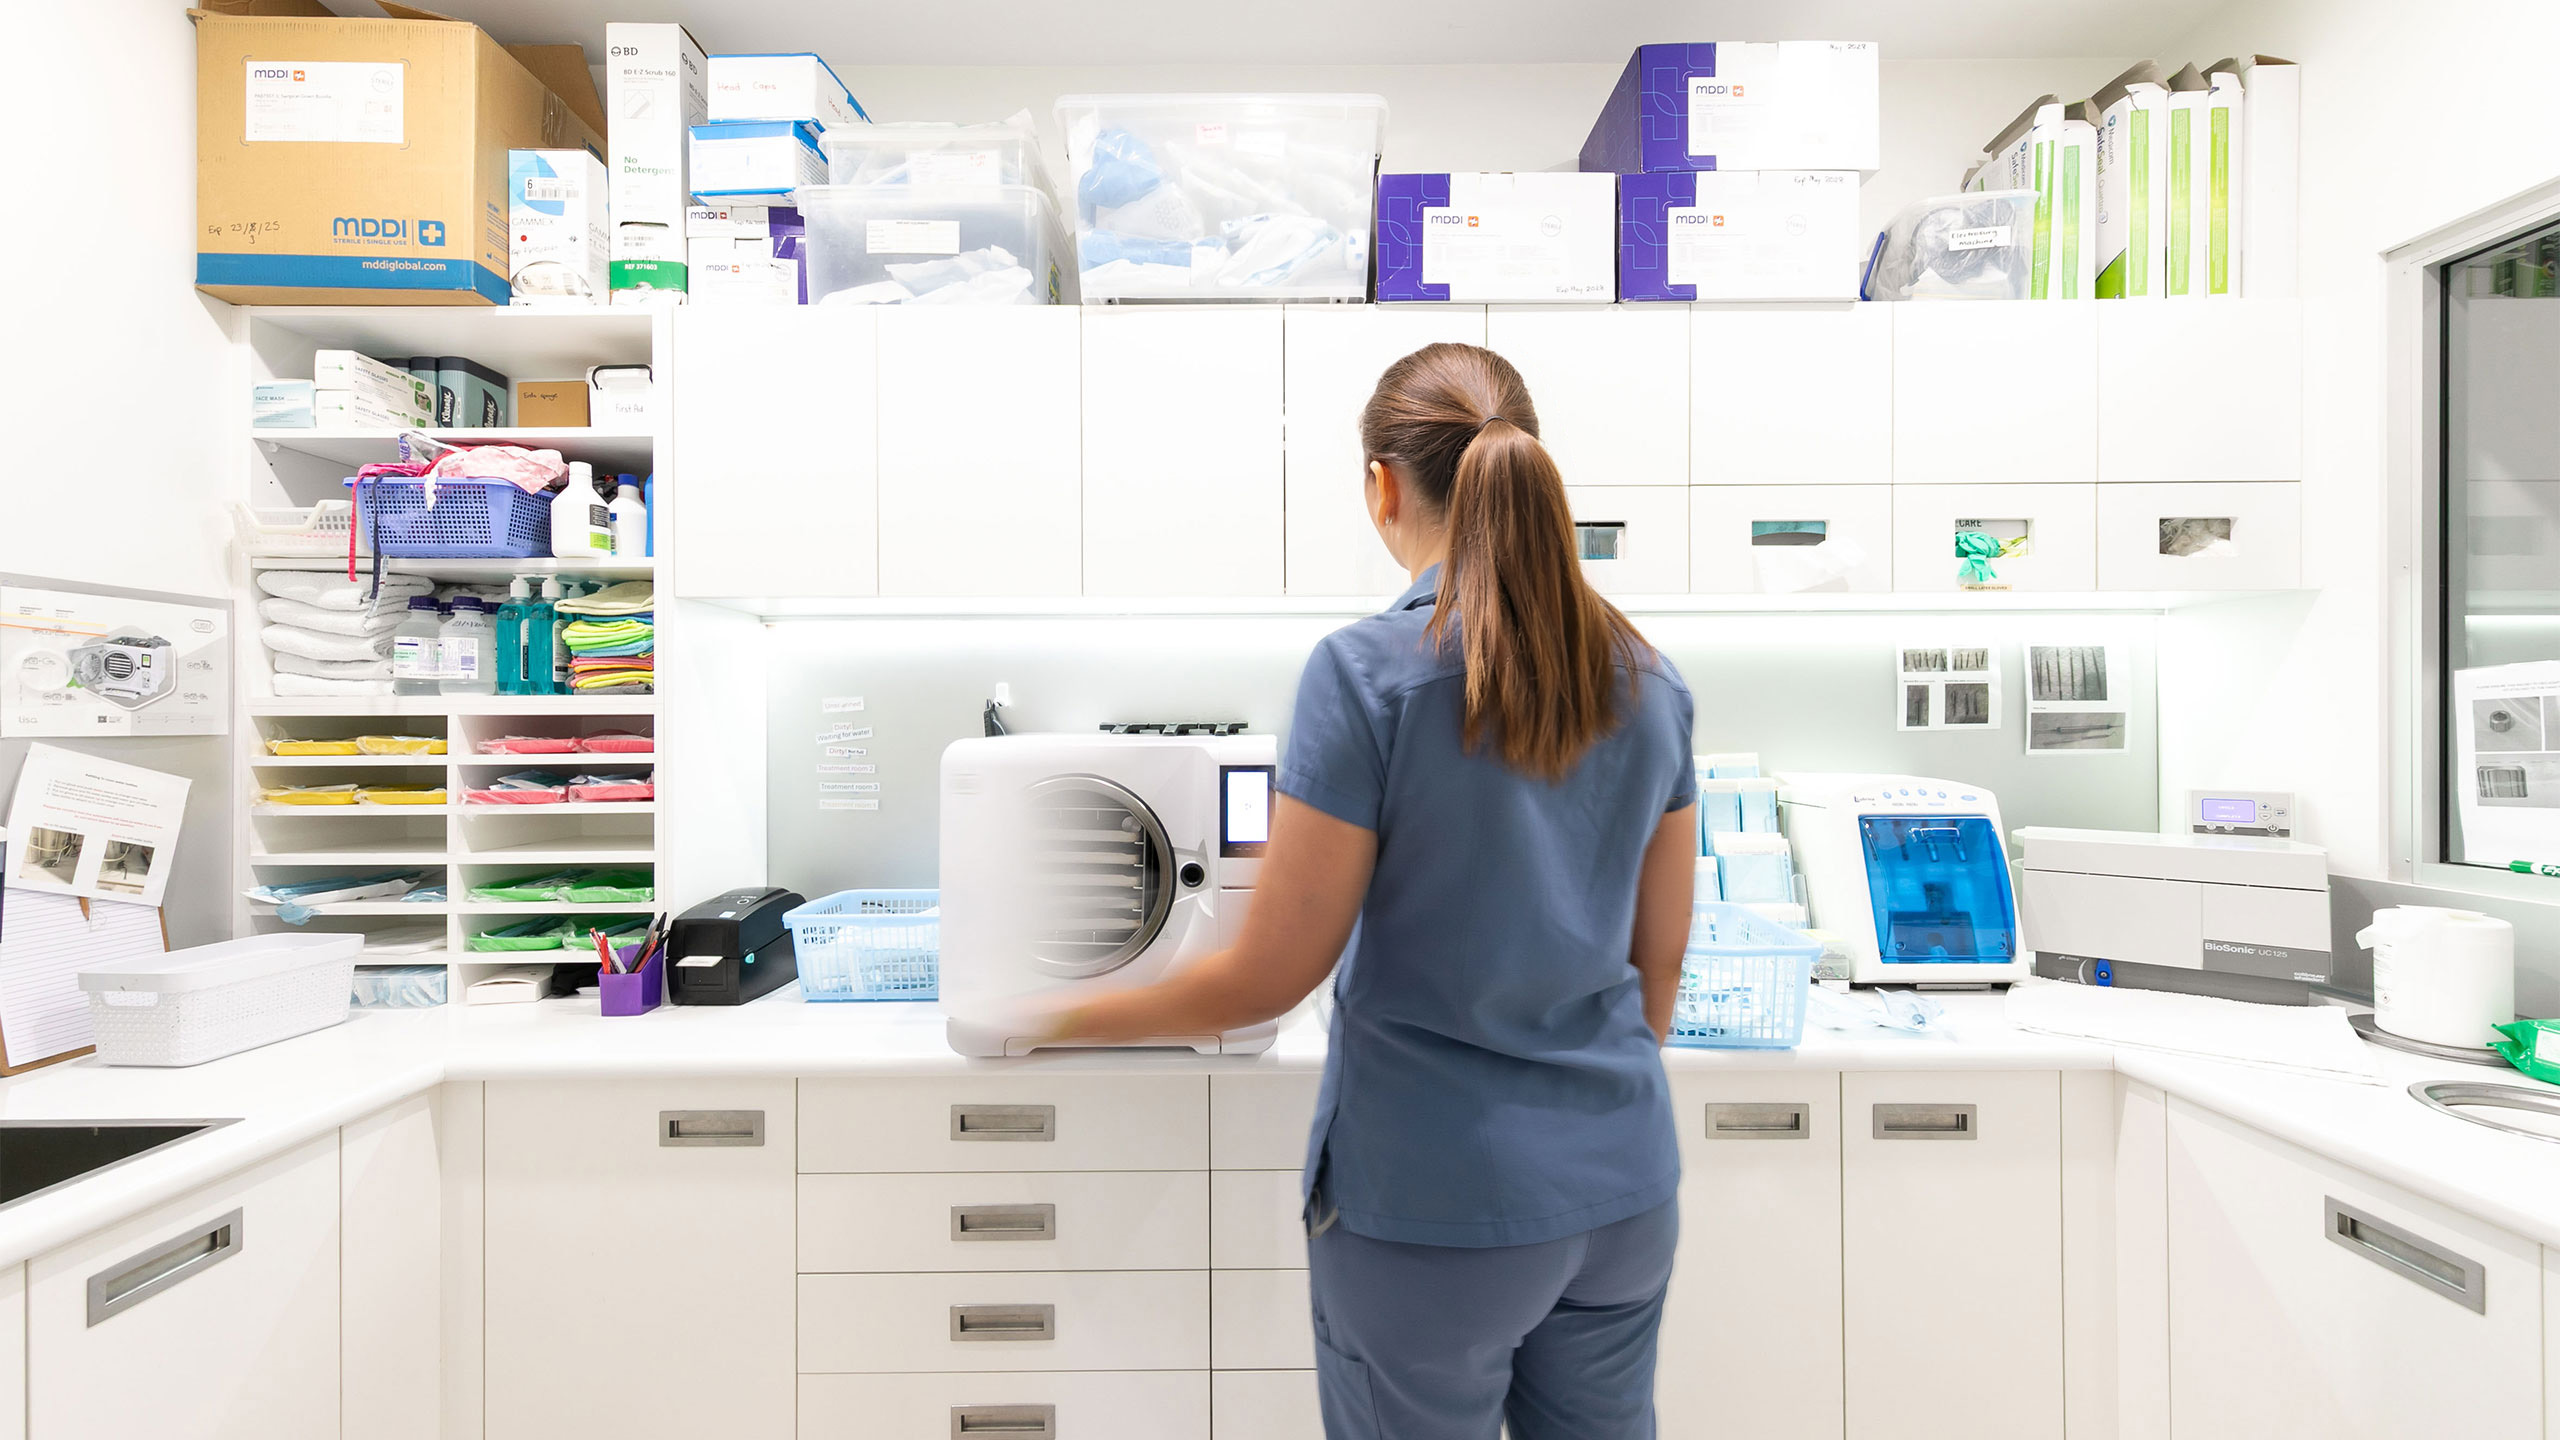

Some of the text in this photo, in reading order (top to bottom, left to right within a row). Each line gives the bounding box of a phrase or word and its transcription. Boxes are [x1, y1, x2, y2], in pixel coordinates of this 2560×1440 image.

[623, 47, 638, 56] BD
[254, 69, 288, 79] MDDI
[645, 68, 663, 76] Scrub
[717, 81, 776, 92] Head Caps
[1695, 85, 1728, 95] MDDI
[828, 95, 841, 117] Head
[2096, 126, 2105, 175] SafeSeal
[624, 156, 638, 164] No
[624, 165, 676, 177] Detergent
[527, 179, 533, 189] 6
[690, 211, 718, 220] MDDI
[1431, 215, 1463, 225] MDDI
[1675, 215, 1708, 225] MDDI
[511, 217, 554, 226] GAMMEX
[208, 224, 223, 235] Exp
[333, 217, 407, 238] MDDI
[362, 260, 447, 272] mddiglobal.com
[705, 264, 729, 272] MDDI
[354, 365, 389, 383] SAFETY GLASSES
[442, 391, 453, 422] Kleenex
[615, 403, 644, 413] First Aid
[354, 405, 390, 421] SAFETY GLASSES
[484, 399, 497, 427] leenex
[817, 732, 842, 742] Waiting
[852, 729, 870, 737] water
[818, 764, 850, 772] Treatment
[821, 783, 854, 791] Treatment
[873, 783, 879, 791] 3
[2204, 942, 2255, 955] BioSonic
